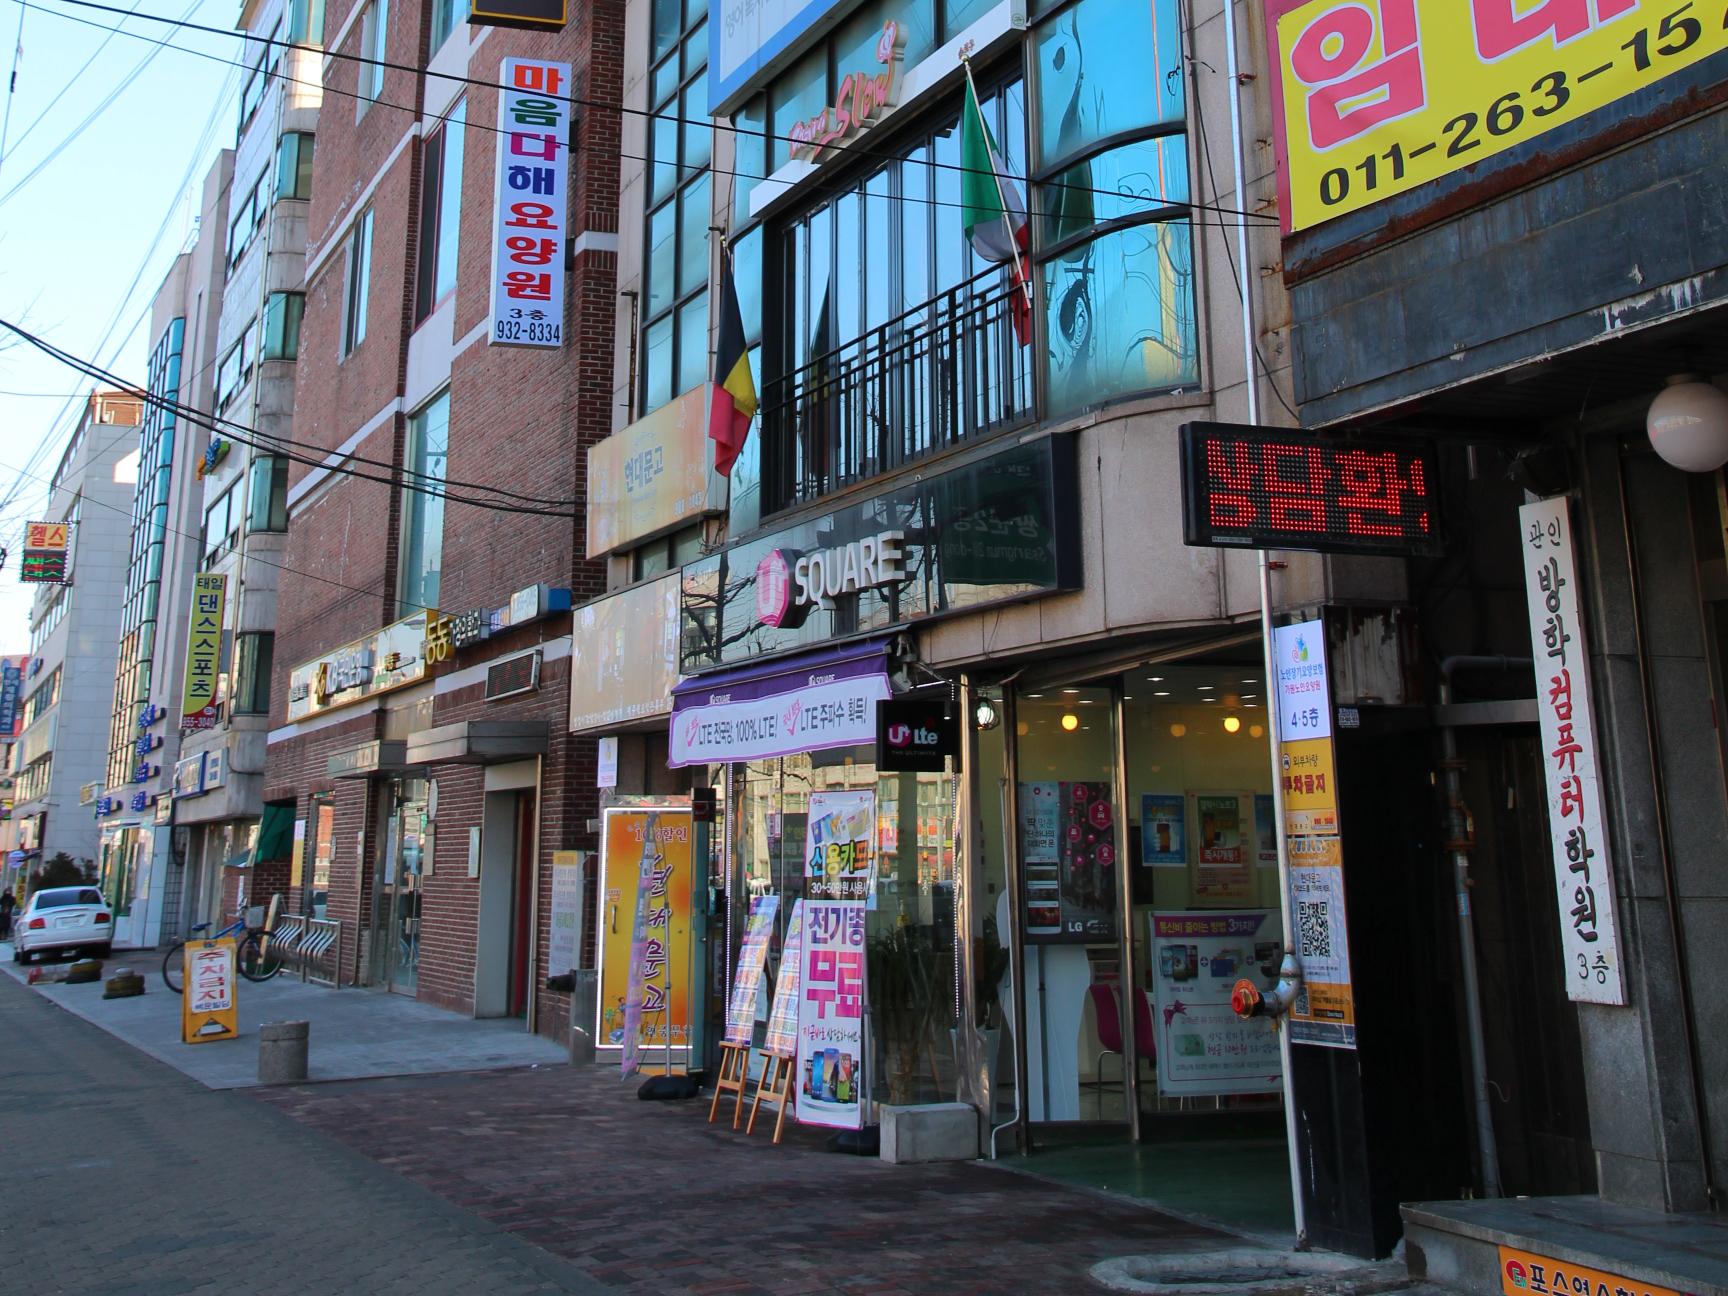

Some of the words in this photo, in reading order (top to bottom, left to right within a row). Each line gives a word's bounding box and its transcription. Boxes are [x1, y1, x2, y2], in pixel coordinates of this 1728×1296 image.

[497, 320, 561, 343] 932-8334
[31, 525, 64, 547] 헬스
[1529, 515, 1562, 549] 관인
[197, 577, 223, 591] 태일
[795, 530, 905, 610] SQUARE
[190, 594, 219, 698] 댄스스포츠
[699, 723, 713, 745] LTE
[736, 718, 757, 743] 100%
[758, 713, 779, 739] LTE!
[1537, 557, 1598, 943] 방학컴퓨터학원
[810, 839, 869, 877] 신용카드
[1068, 922, 1083, 932] LG
[1577, 950, 1610, 985] 3층
